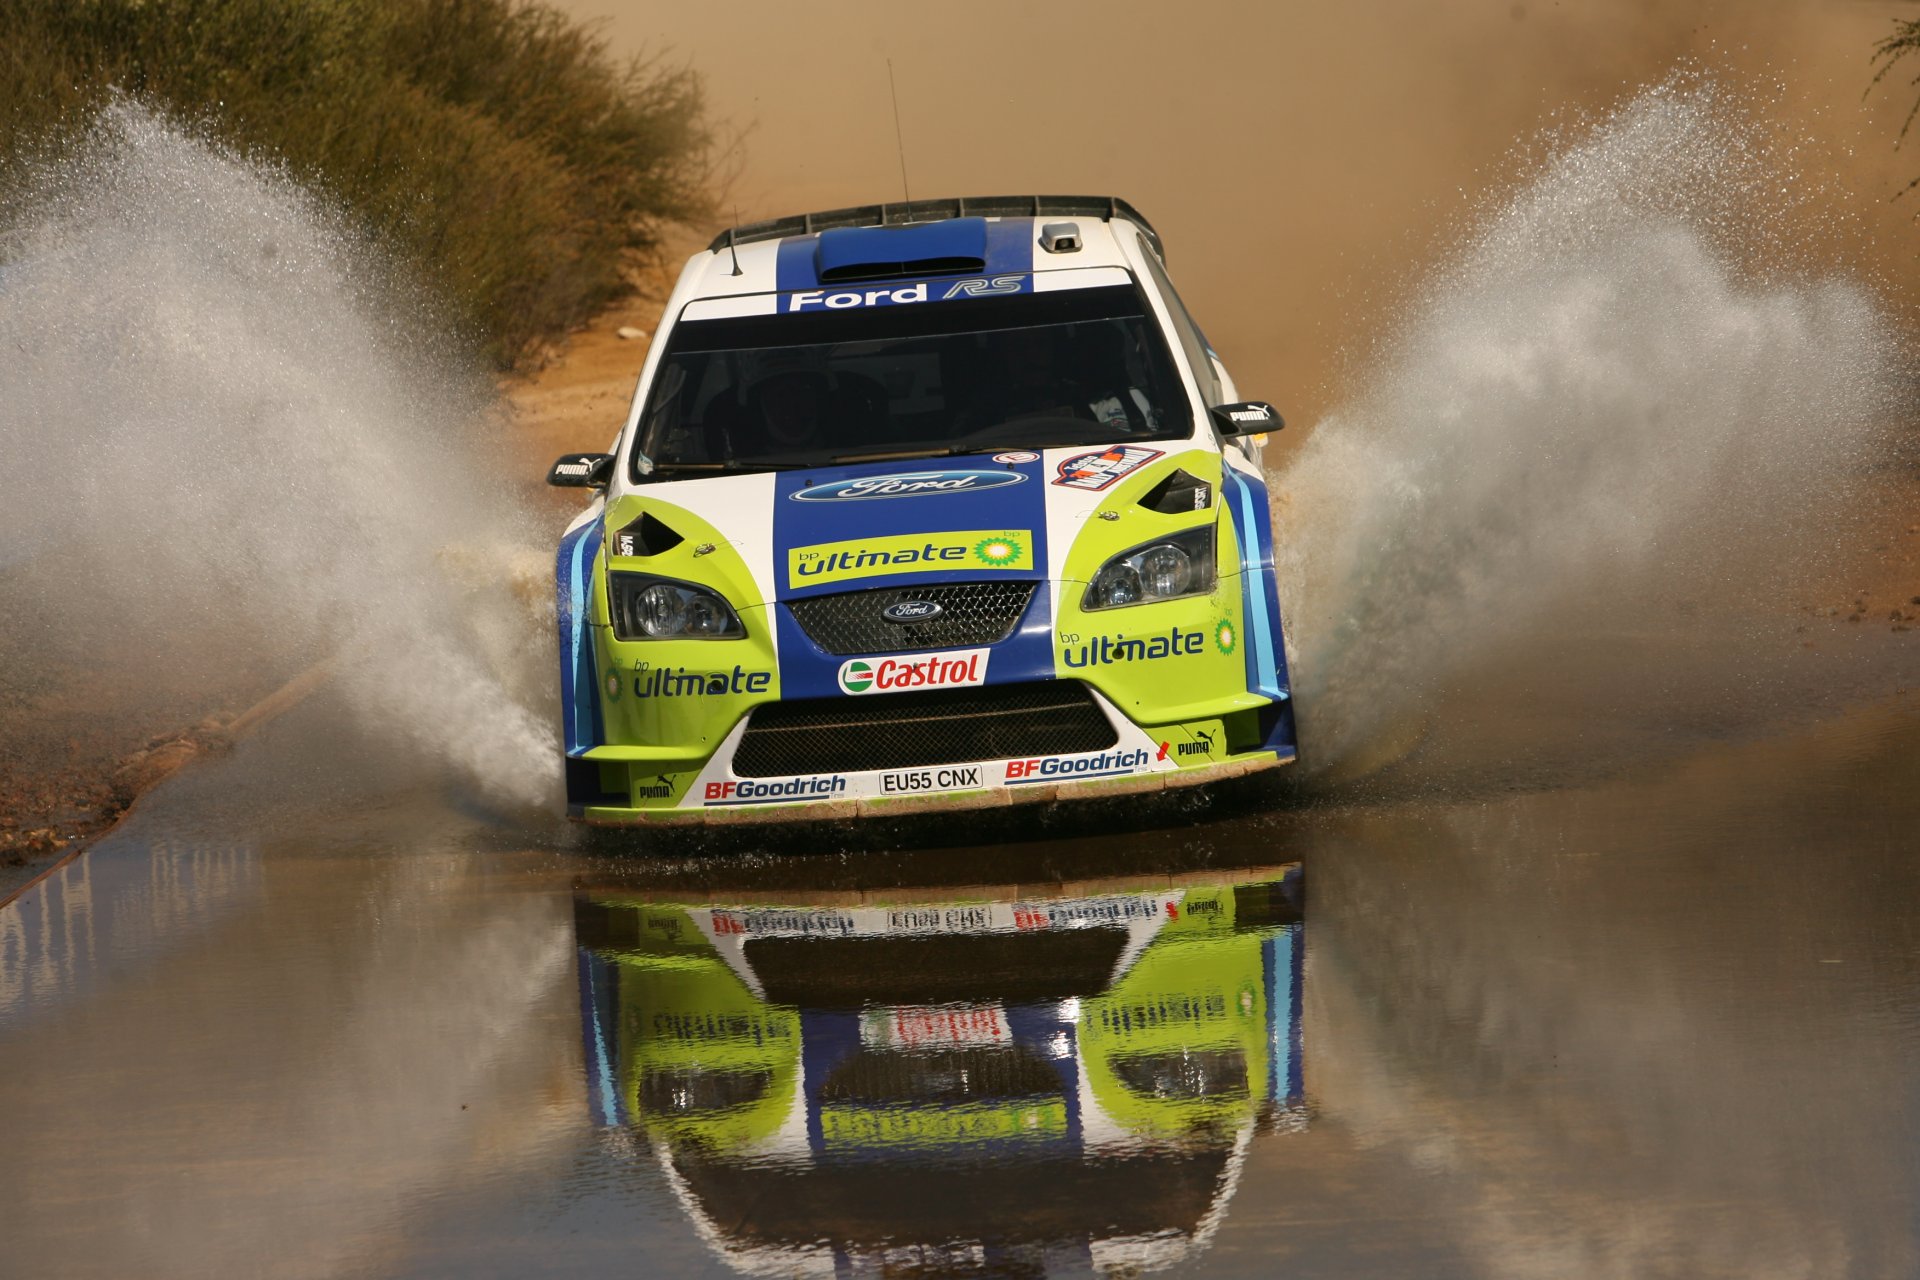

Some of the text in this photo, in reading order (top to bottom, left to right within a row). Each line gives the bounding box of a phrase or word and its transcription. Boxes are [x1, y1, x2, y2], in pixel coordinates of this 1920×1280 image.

[789, 275, 1026, 312] Ford RS
[1230, 410, 1266, 422] PUMA
[555, 464, 588, 475] PUMA
[837, 473, 978, 498] Ford
[798, 543, 967, 576] ultimate
[799, 552, 820, 562] bp
[895, 602, 928, 616] Ford
[1059, 631, 1080, 645] bp
[1064, 627, 1204, 668] ultimate
[634, 657, 649, 675] bp
[876, 654, 978, 689] Castrol
[634, 665, 771, 698] ultimate
[1178, 741, 1208, 756] PUMA
[1005, 748, 1149, 779] BFGoodrich
[704, 775, 846, 799] BFGoodrich
[883, 767, 979, 792] EU55 CNX
[639, 785, 670, 799] PUMA
